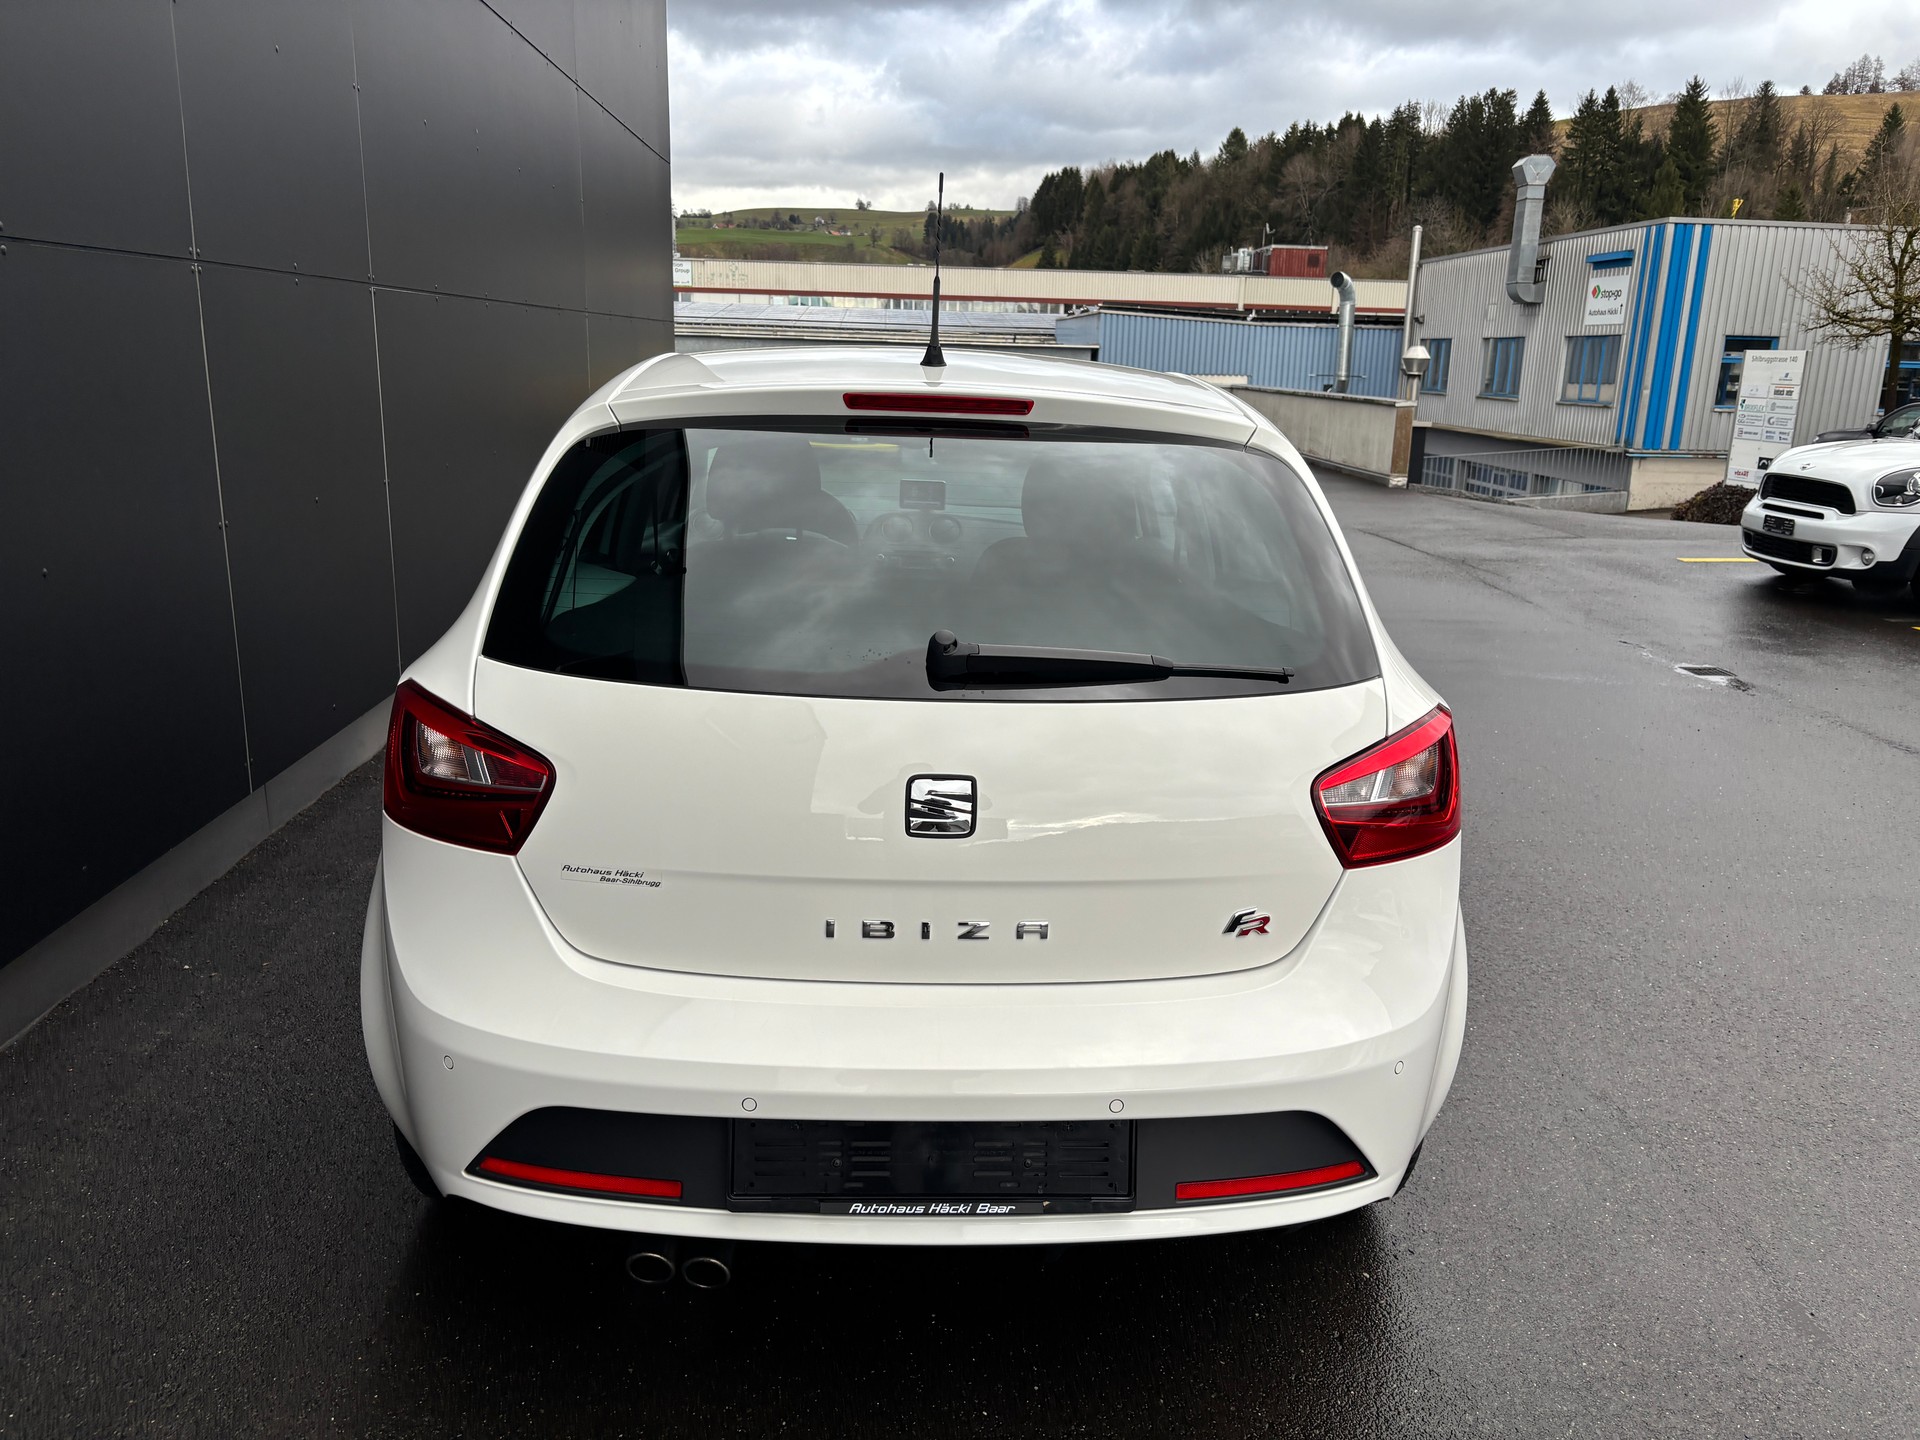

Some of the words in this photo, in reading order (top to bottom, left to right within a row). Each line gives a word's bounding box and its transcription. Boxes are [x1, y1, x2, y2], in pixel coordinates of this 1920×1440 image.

[1588, 308, 1606, 316] Autohaus
[562, 864, 612, 876] Autohaus
[615, 869, 644, 878] Häcki
[599, 875, 661, 888] Baar-Sihlbrugg
[1222, 906, 1271, 937] FR
[825, 919, 1049, 940] IBIZA
[849, 1203, 925, 1214] Autohaus
[928, 1203, 972, 1214] Häcki
[976, 1203, 1016, 1214] Baar
